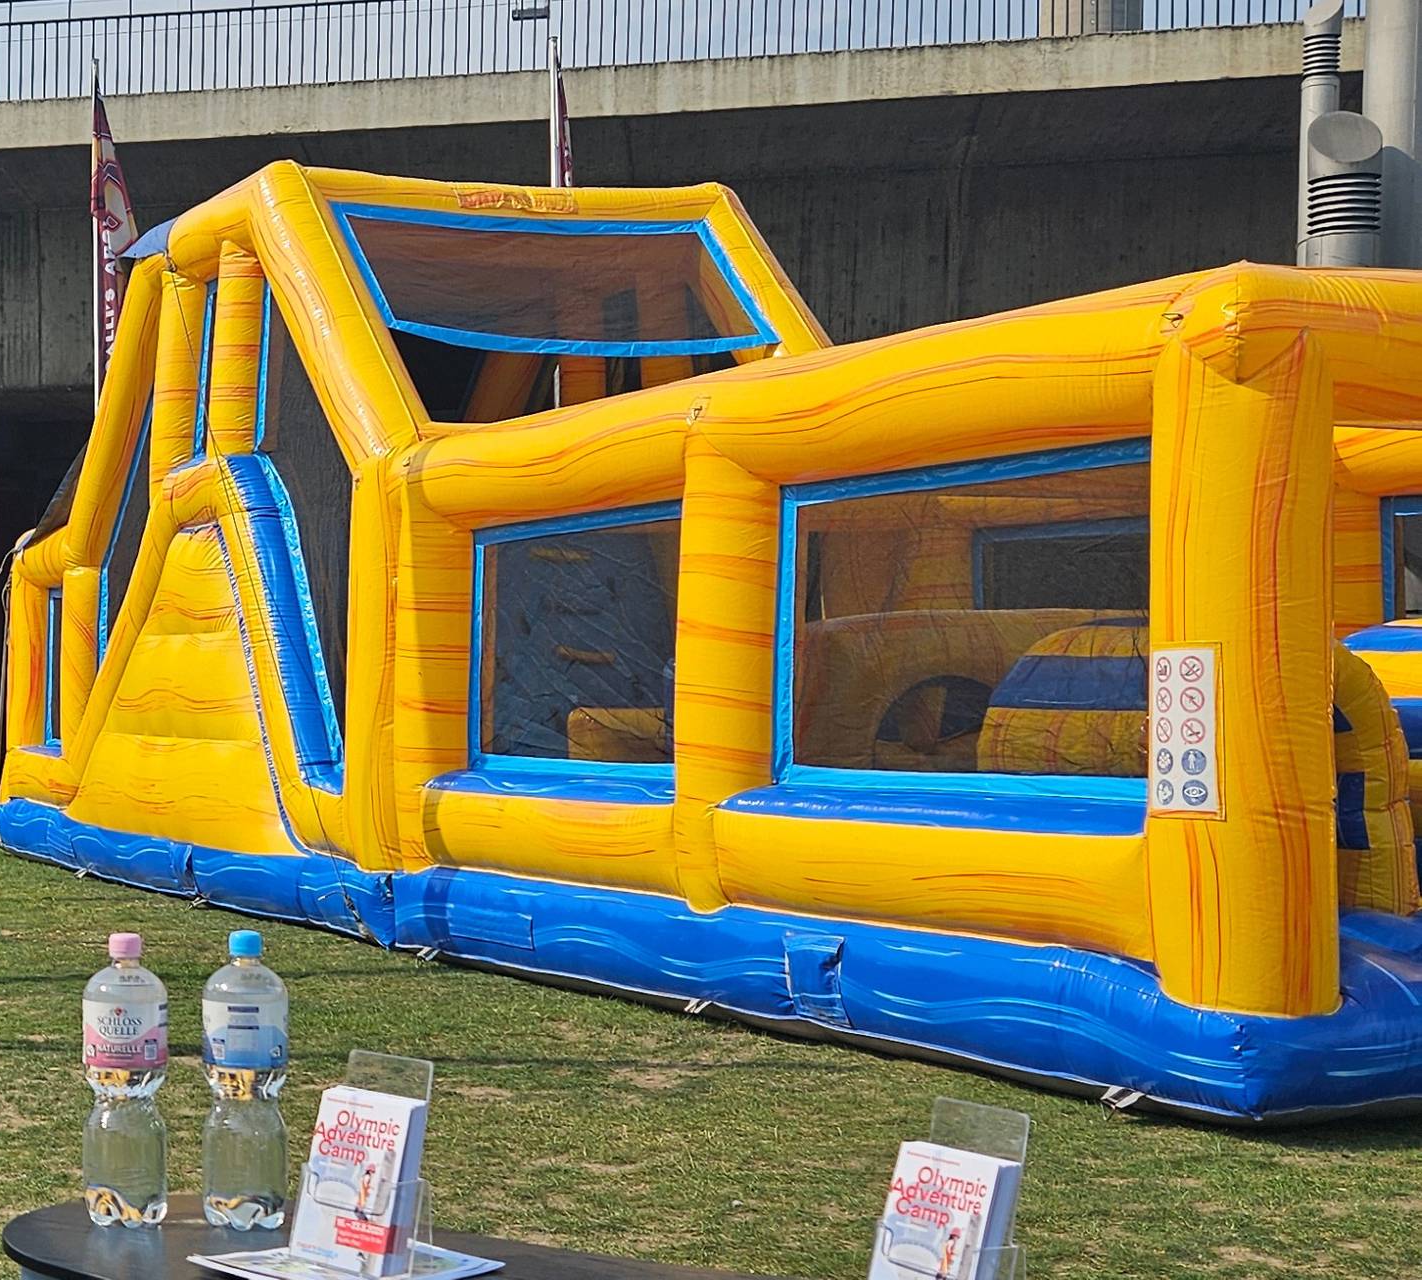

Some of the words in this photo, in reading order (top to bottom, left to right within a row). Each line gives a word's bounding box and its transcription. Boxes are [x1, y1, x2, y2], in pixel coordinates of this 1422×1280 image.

[97, 1016, 143, 1026] SCHLOSS
[98, 1025, 138, 1037] QUELLE
[97, 1044, 142, 1054] NATURELLE
[315, 1121, 395, 1151] Adventure
[337, 1110, 401, 1137] Olympic
[318, 1139, 366, 1166] Camp
[918, 1166, 987, 1198] Olympic
[891, 1177, 982, 1215] Adventure
[895, 1197, 951, 1229] Camp
